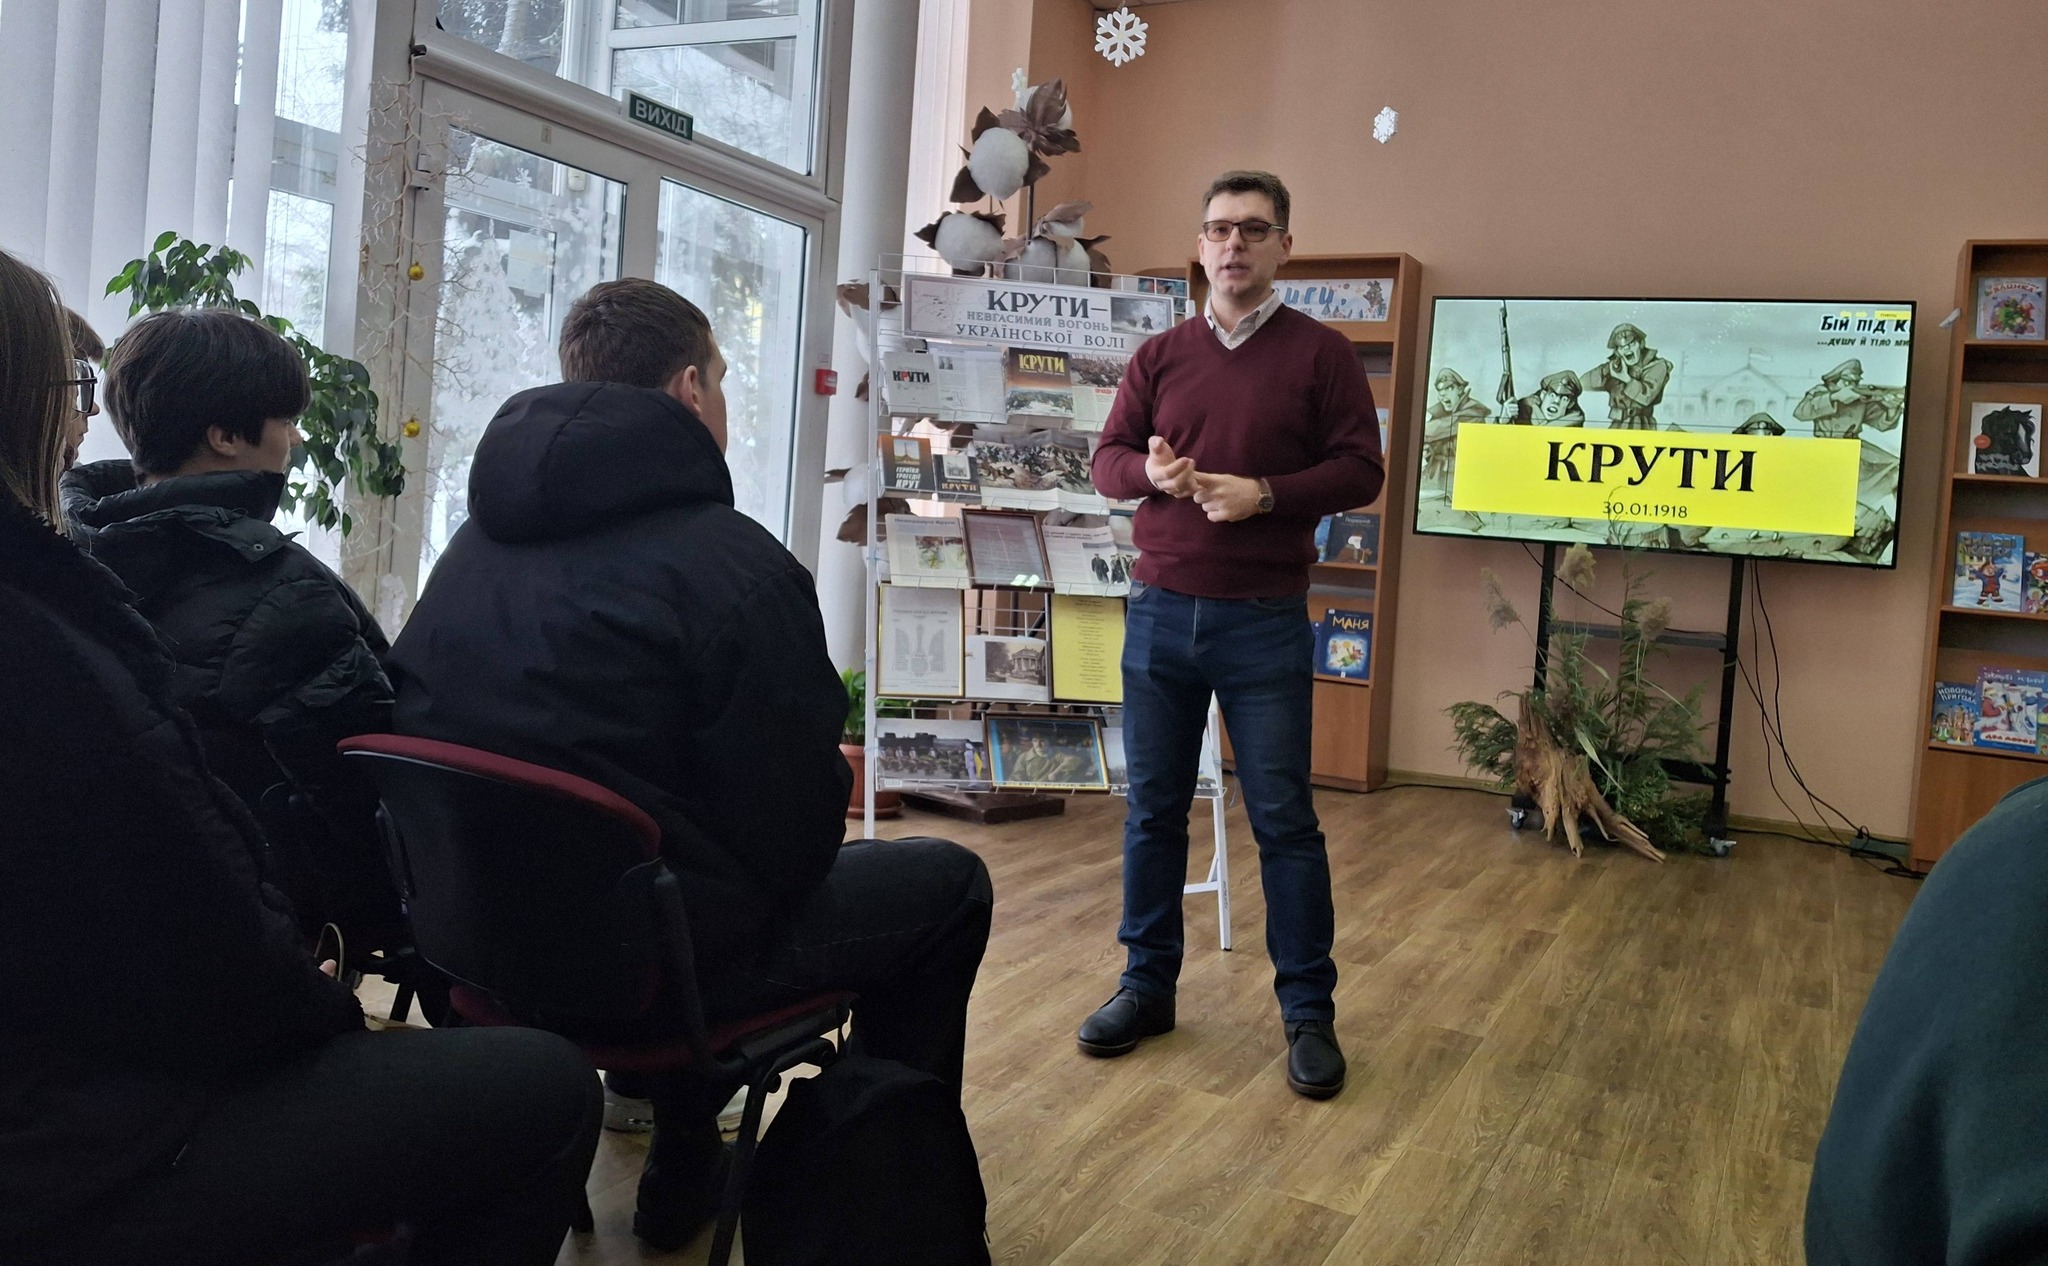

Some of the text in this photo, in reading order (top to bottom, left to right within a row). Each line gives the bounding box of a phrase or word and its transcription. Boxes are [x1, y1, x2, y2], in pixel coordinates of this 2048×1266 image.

[635, 99, 688, 137] ВИХІД
[966, 311, 1110, 332] НЕВГАСИМИЙ ВОГОНЬ
[1894, 319, 1908, 332] К
[955, 323, 1125, 349] УКРАЇНСЬКОЇ ВОЛІ
[1018, 353, 1065, 373] КРУТИ
[1545, 441, 1758, 492] КРУТИ
[895, 480, 920, 489] КРУТ
[941, 482, 977, 491] КРУТИ
[1602, 501, 1688, 518] 30.01.1918
[1332, 615, 1370, 630] МАНЯ
